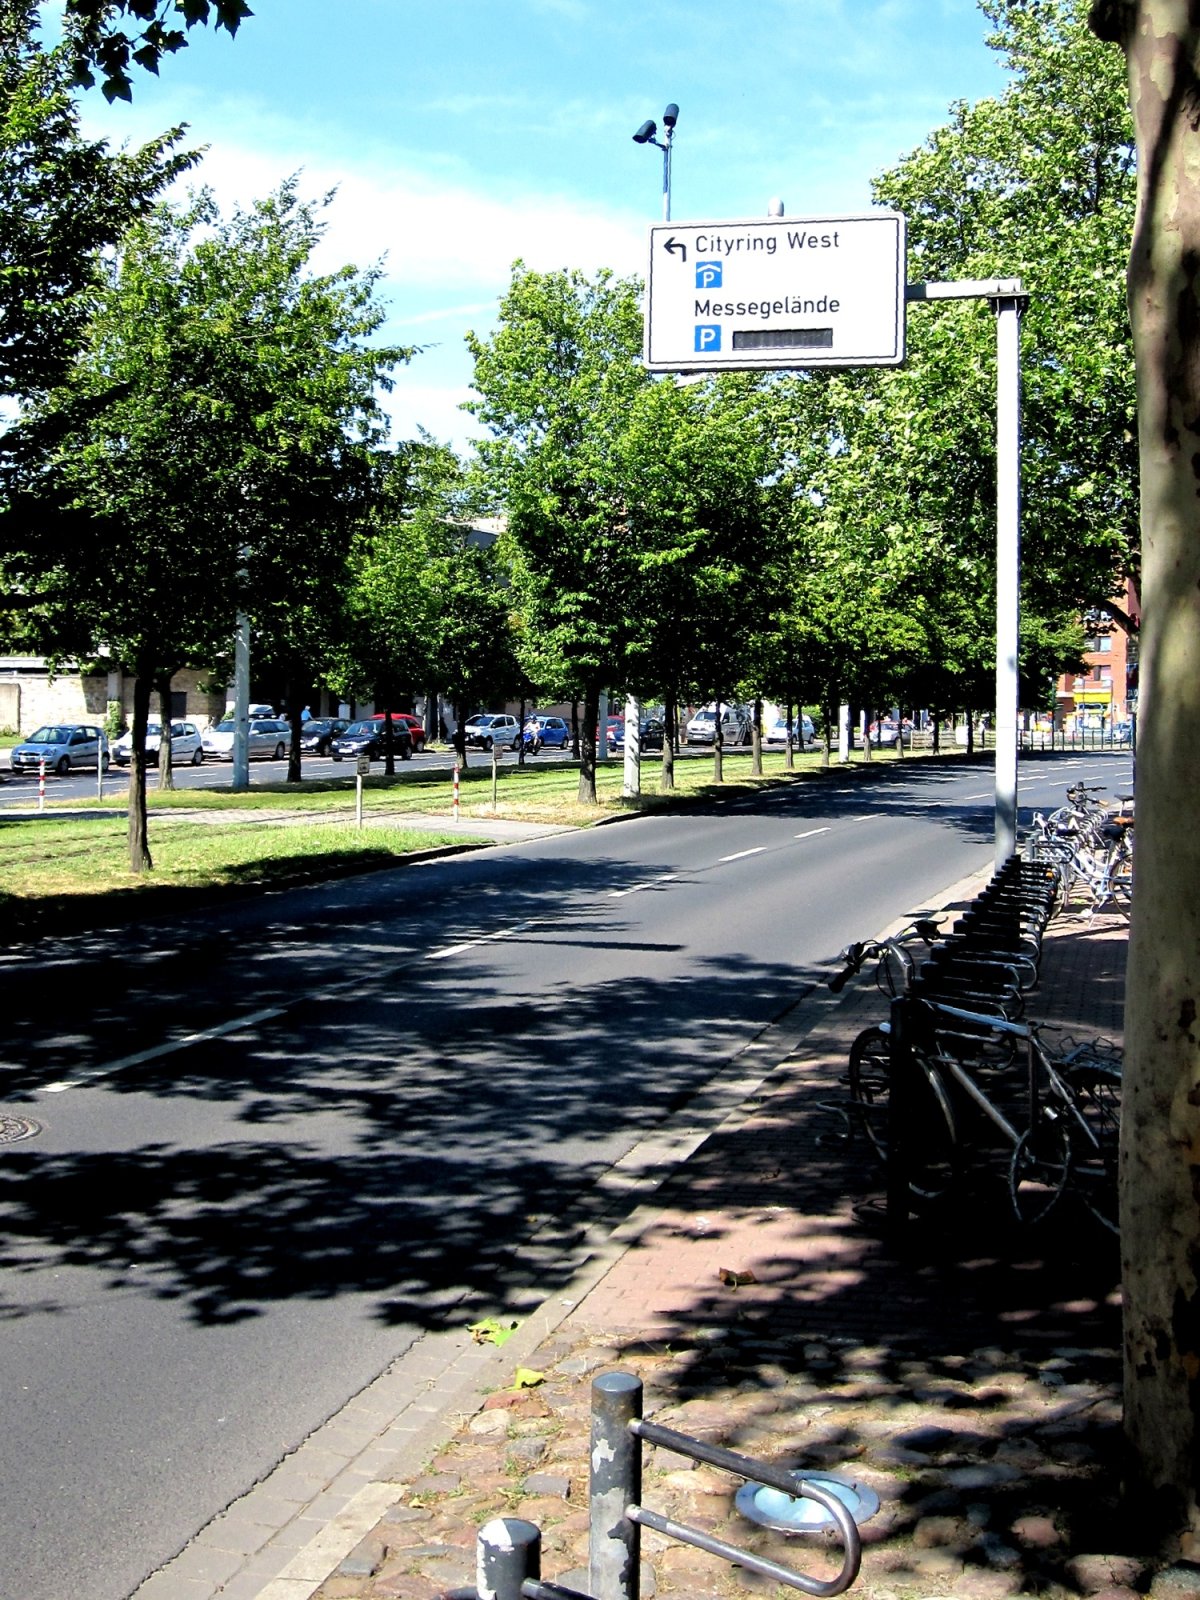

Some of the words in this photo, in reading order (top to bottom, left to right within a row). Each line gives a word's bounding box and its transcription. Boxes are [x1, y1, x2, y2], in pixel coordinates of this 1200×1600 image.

[695, 233, 778, 257] Cityring
[787, 231, 840, 250] West
[703, 271, 715, 288] P
[694, 295, 841, 319] Messegelände
[700, 328, 716, 350] P
